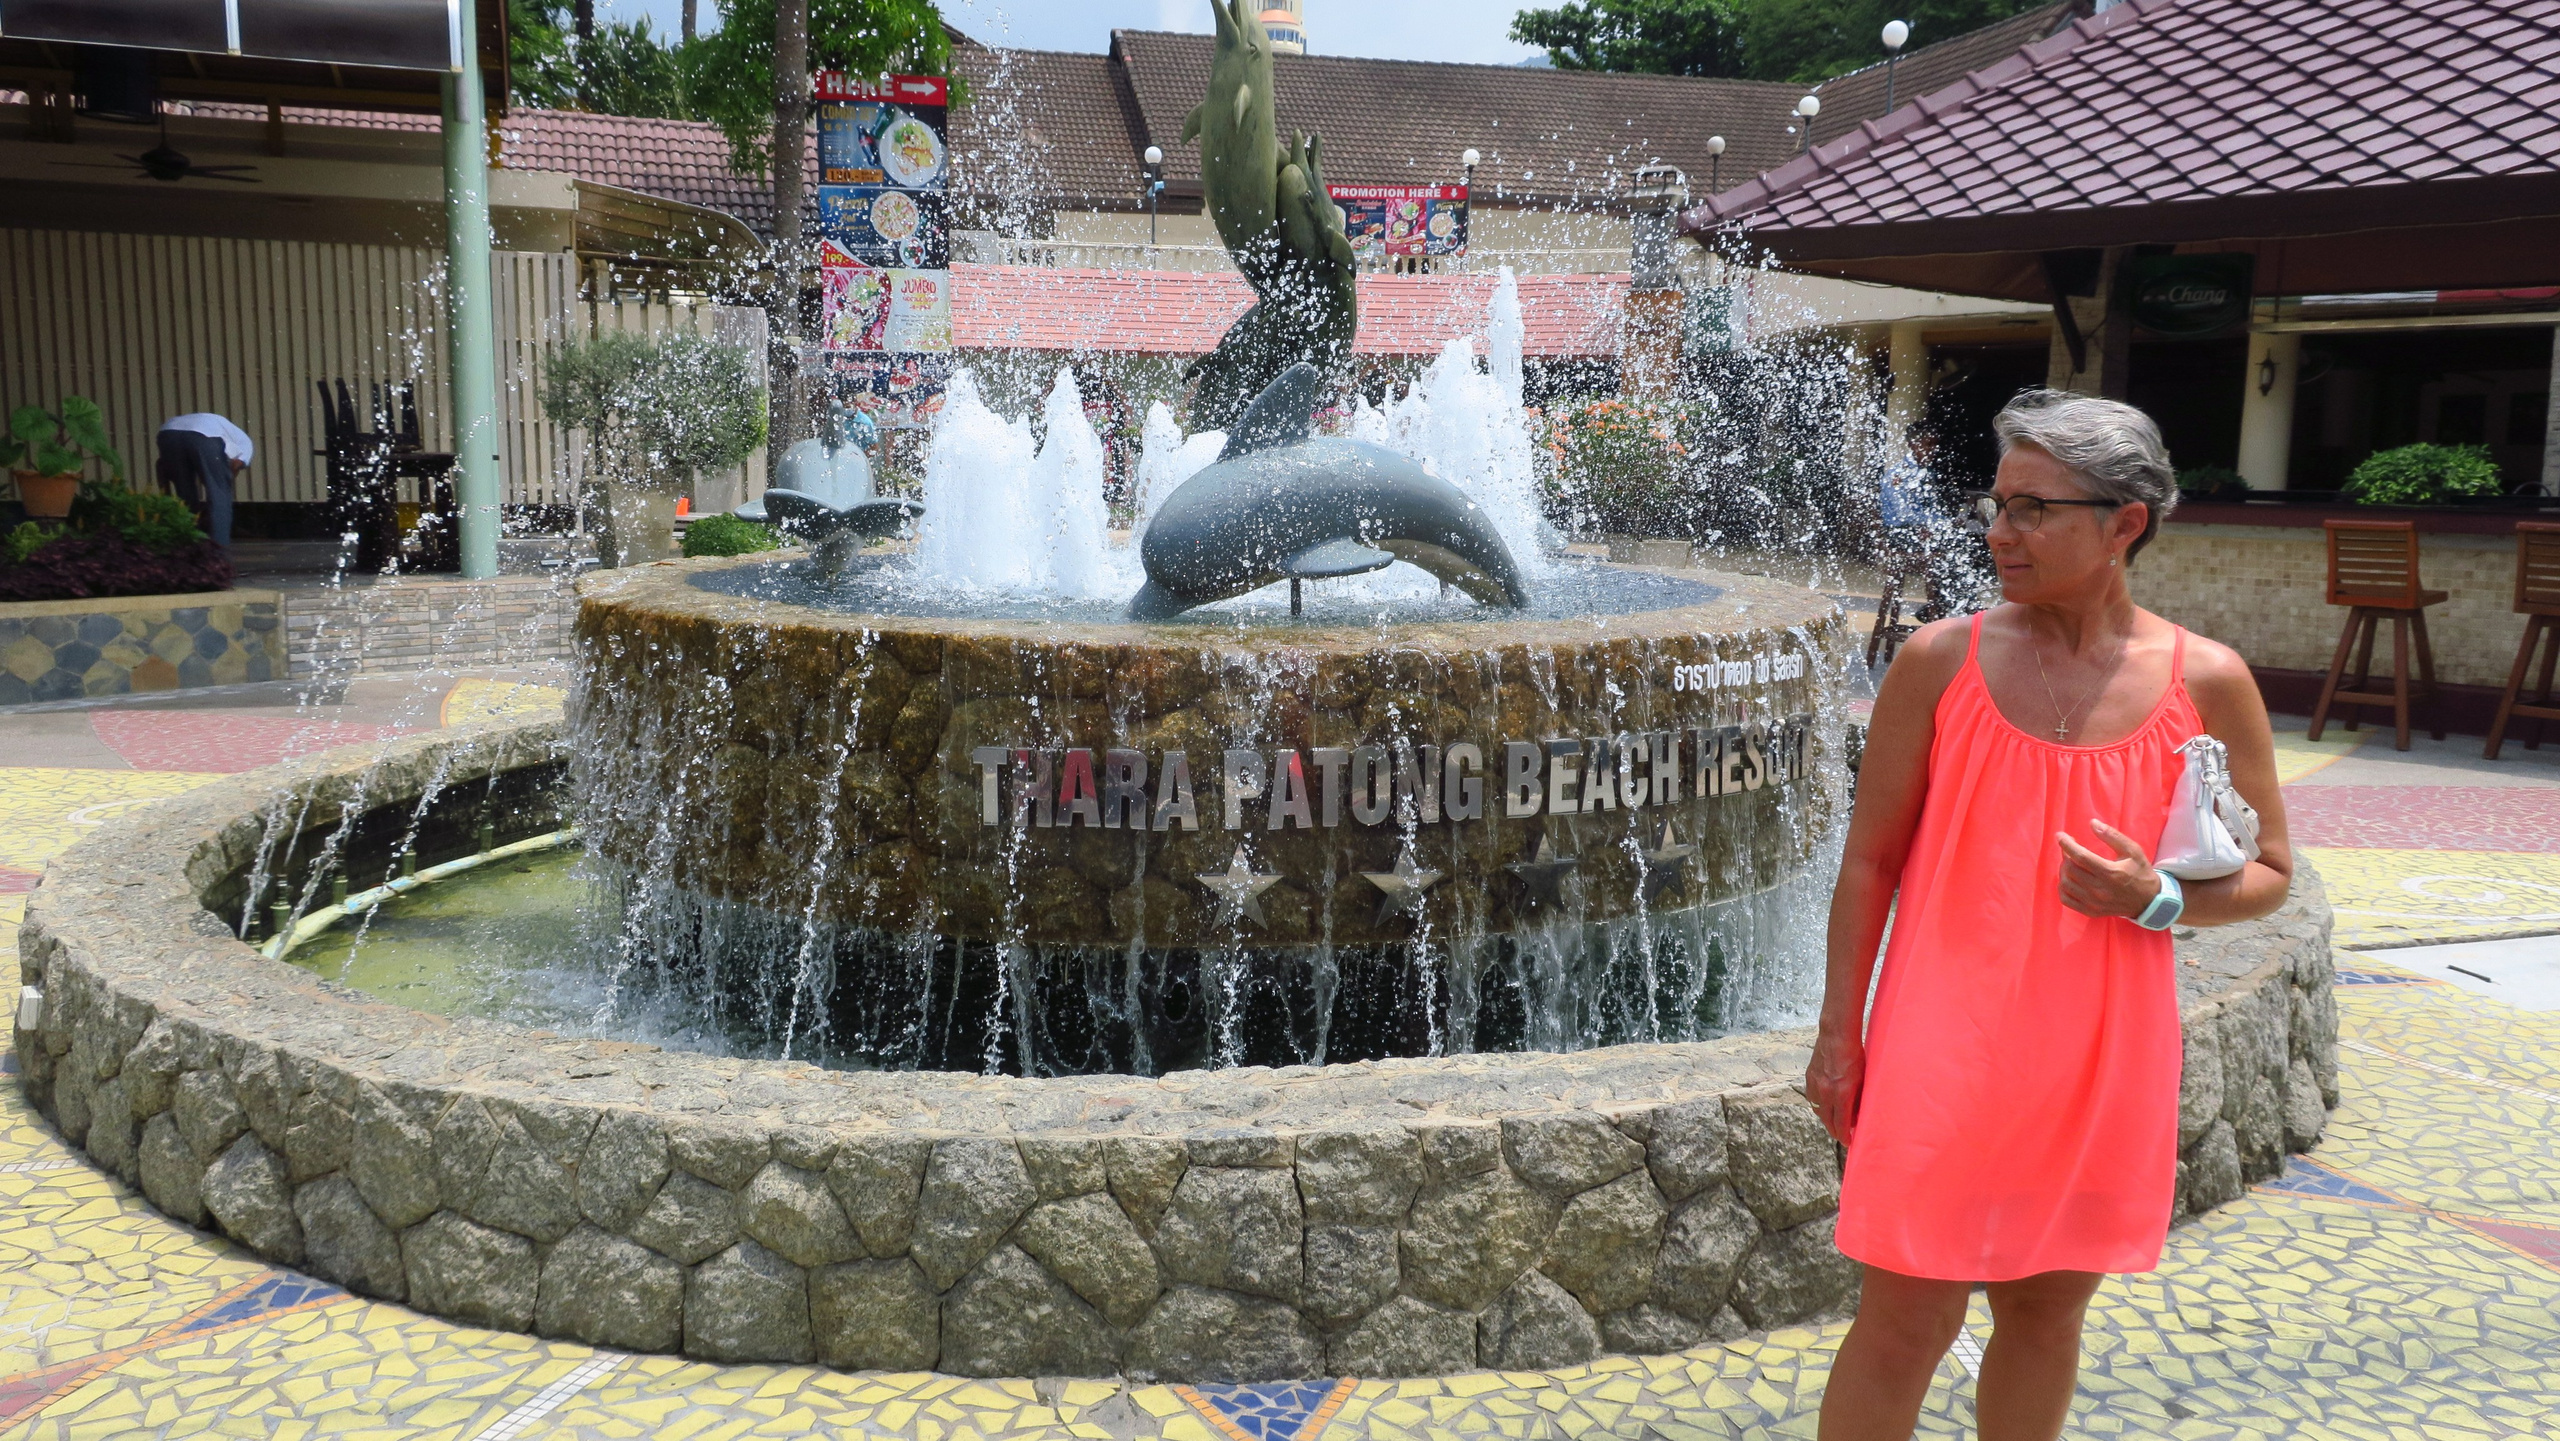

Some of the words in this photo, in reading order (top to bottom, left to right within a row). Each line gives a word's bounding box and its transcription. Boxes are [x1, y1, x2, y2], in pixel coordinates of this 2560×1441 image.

[826, 73, 894, 97] HERE
[1332, 187, 1405, 197] PROMOTION
[1408, 188, 1441, 198] HERE
[900, 279, 937, 294] JUMBO
[2169, 285, 2228, 305] Chang
[972, 746, 1199, 832] THARA
[1223, 742, 1483, 831] PATONG
[1503, 731, 1680, 819] BEACH
[1689, 713, 1813, 801] RESORT
